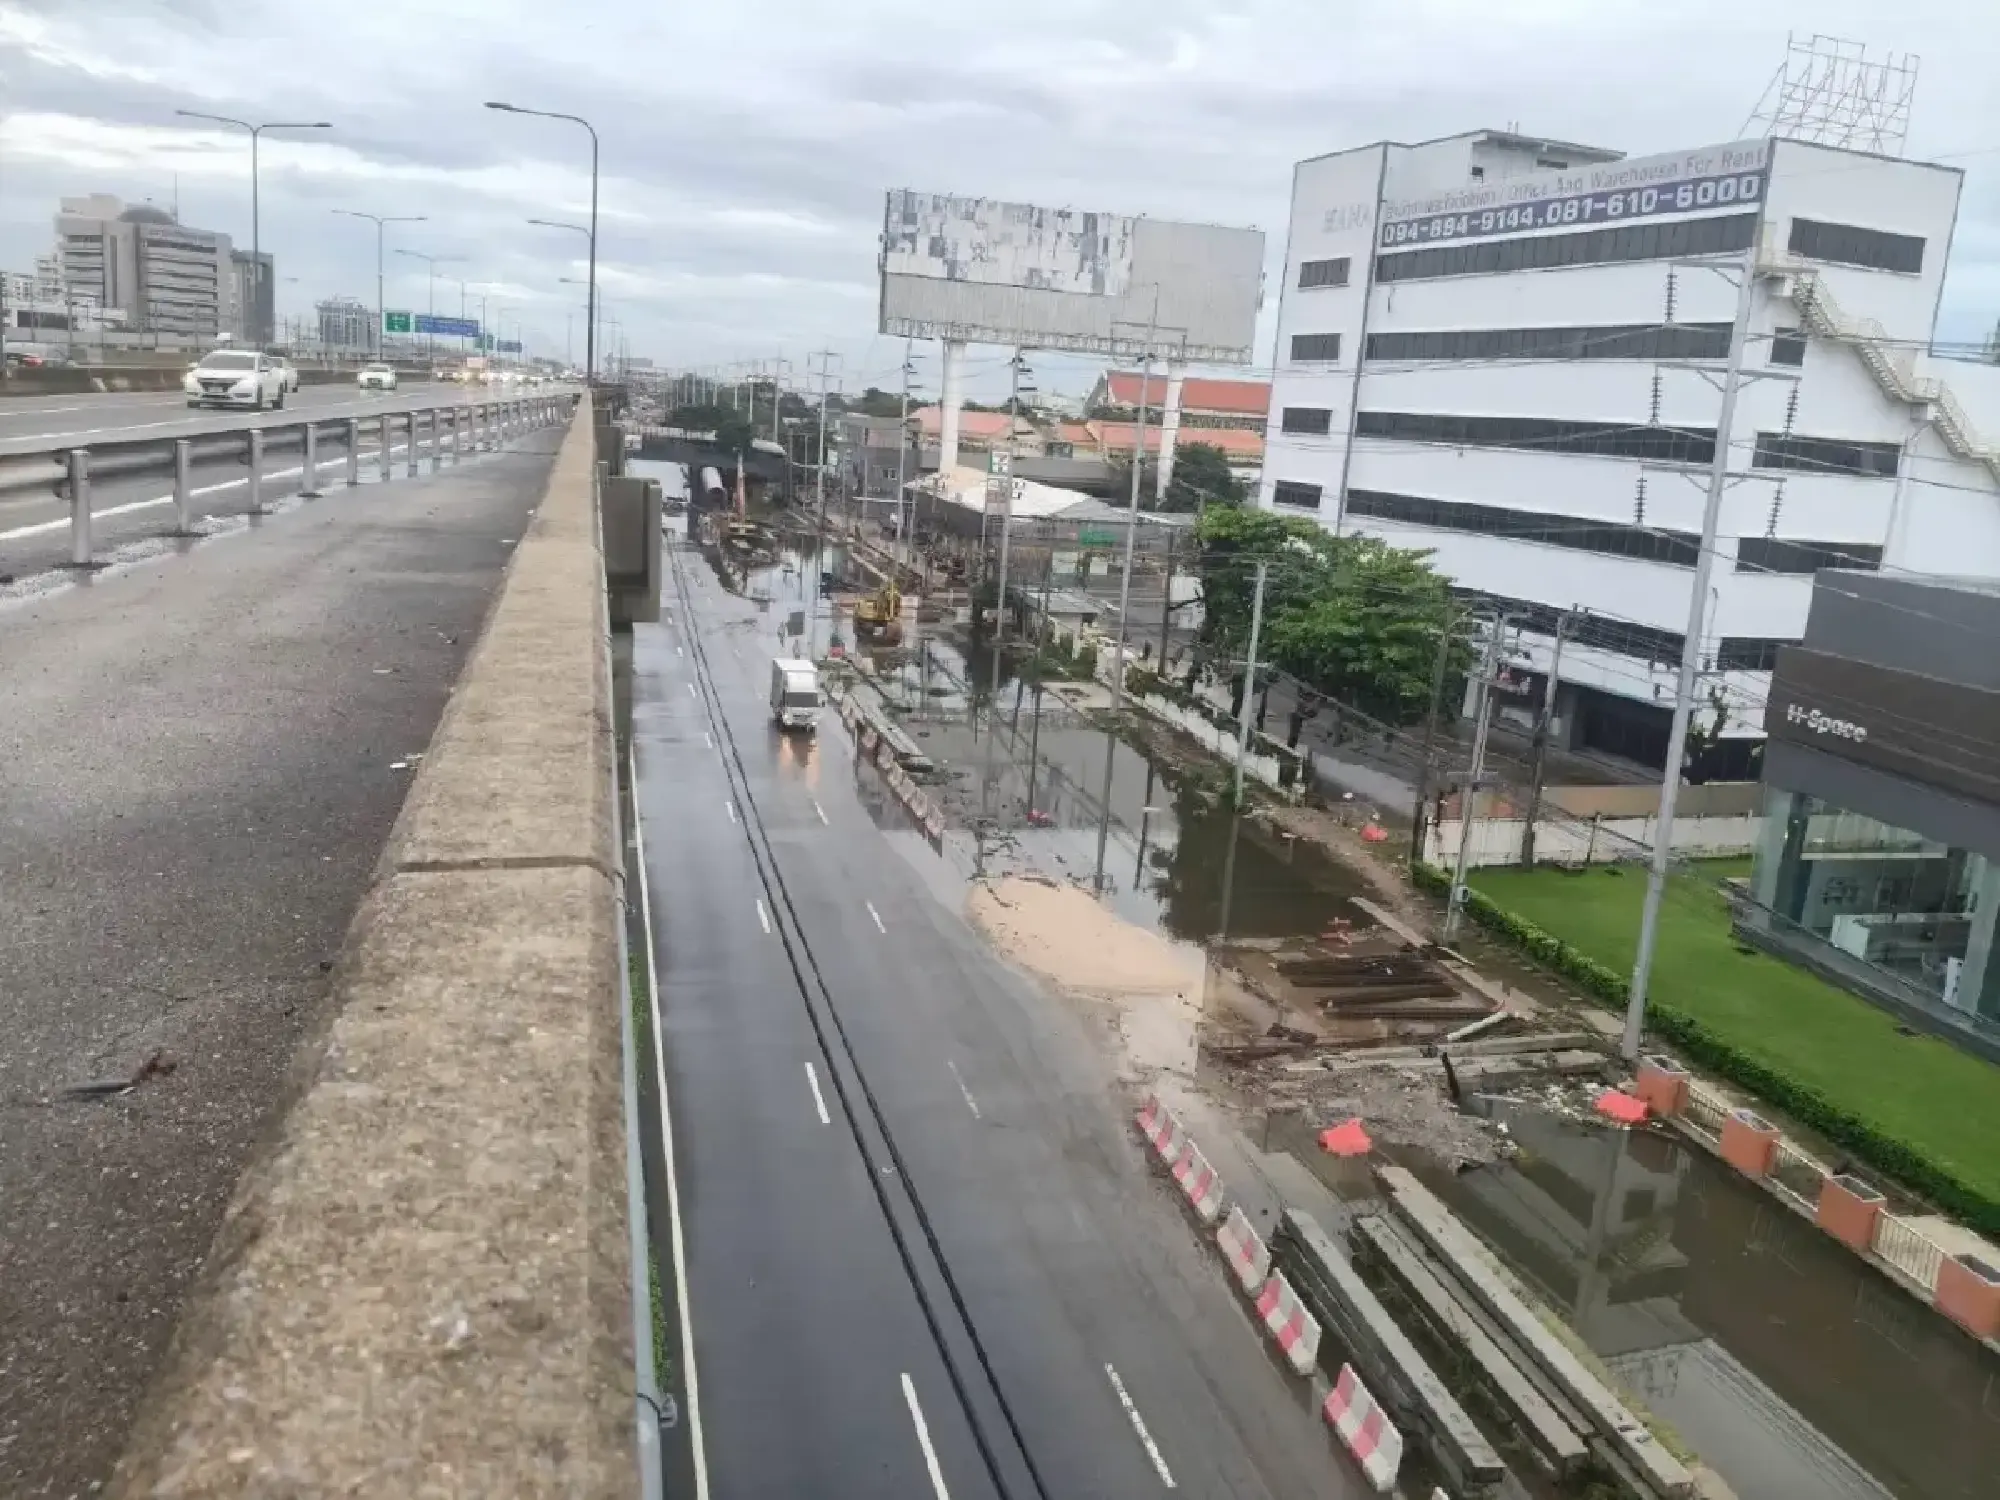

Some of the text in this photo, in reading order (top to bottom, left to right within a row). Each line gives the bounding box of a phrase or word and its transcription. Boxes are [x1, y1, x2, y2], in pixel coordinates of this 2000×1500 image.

[1686, 153, 1714, 175] For
[1721, 146, 1766, 169] Rent
[1786, 703, 1868, 743] H-Space
